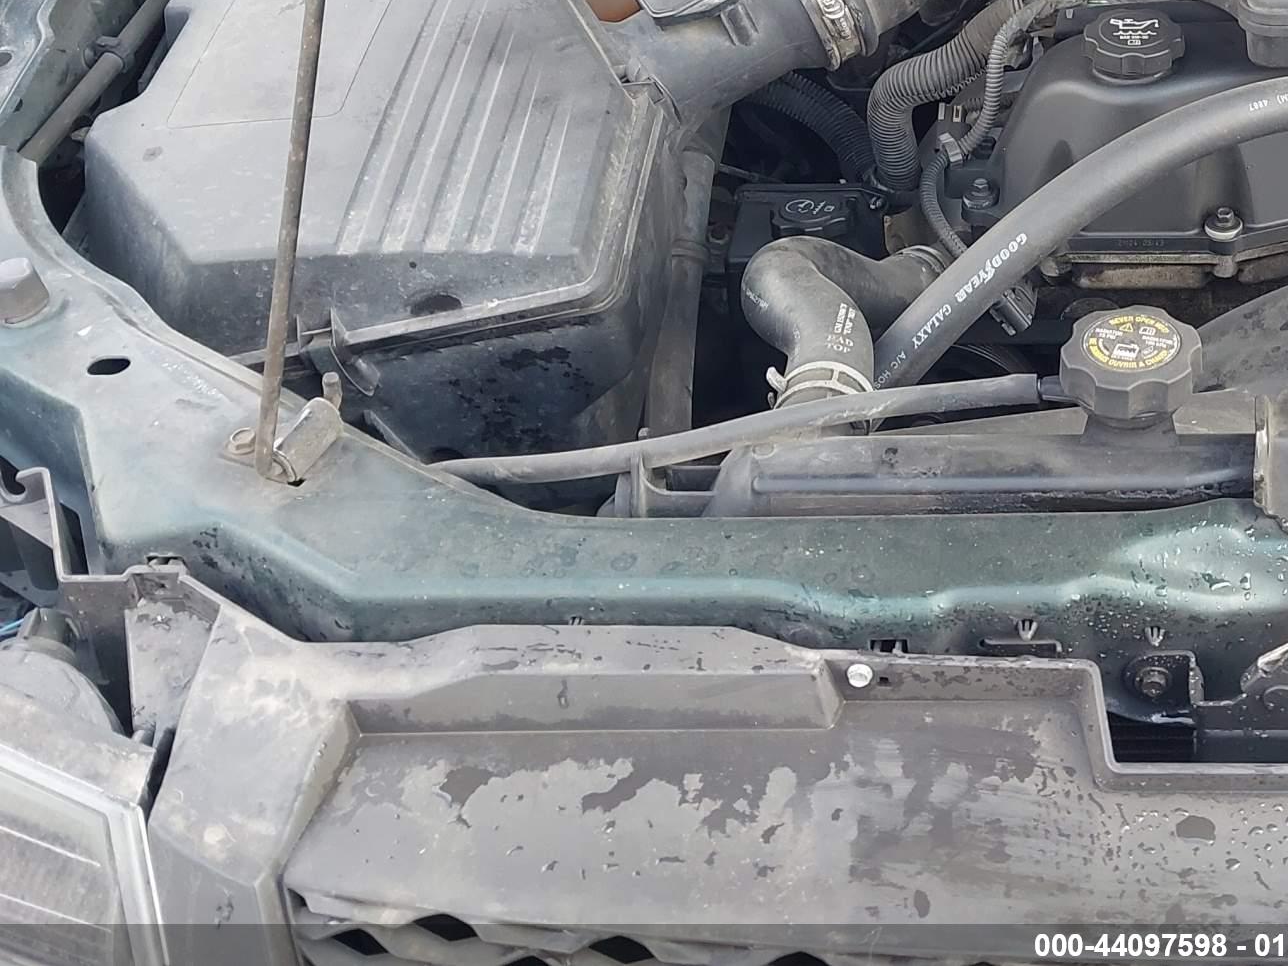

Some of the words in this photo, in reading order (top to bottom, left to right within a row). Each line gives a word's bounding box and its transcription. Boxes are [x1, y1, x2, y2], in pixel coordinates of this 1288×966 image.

[955, 233, 1028, 303] GOODYEAR
[911, 304, 952, 349] GALAXY
[1108, 315, 1134, 325] NEVER
[1135, 316, 1155, 325] OPEN
[890, 350, 907, 370] A/C
[1108, 359, 1137, 368] OUVRIR
[874, 370, 892, 391] HOS
